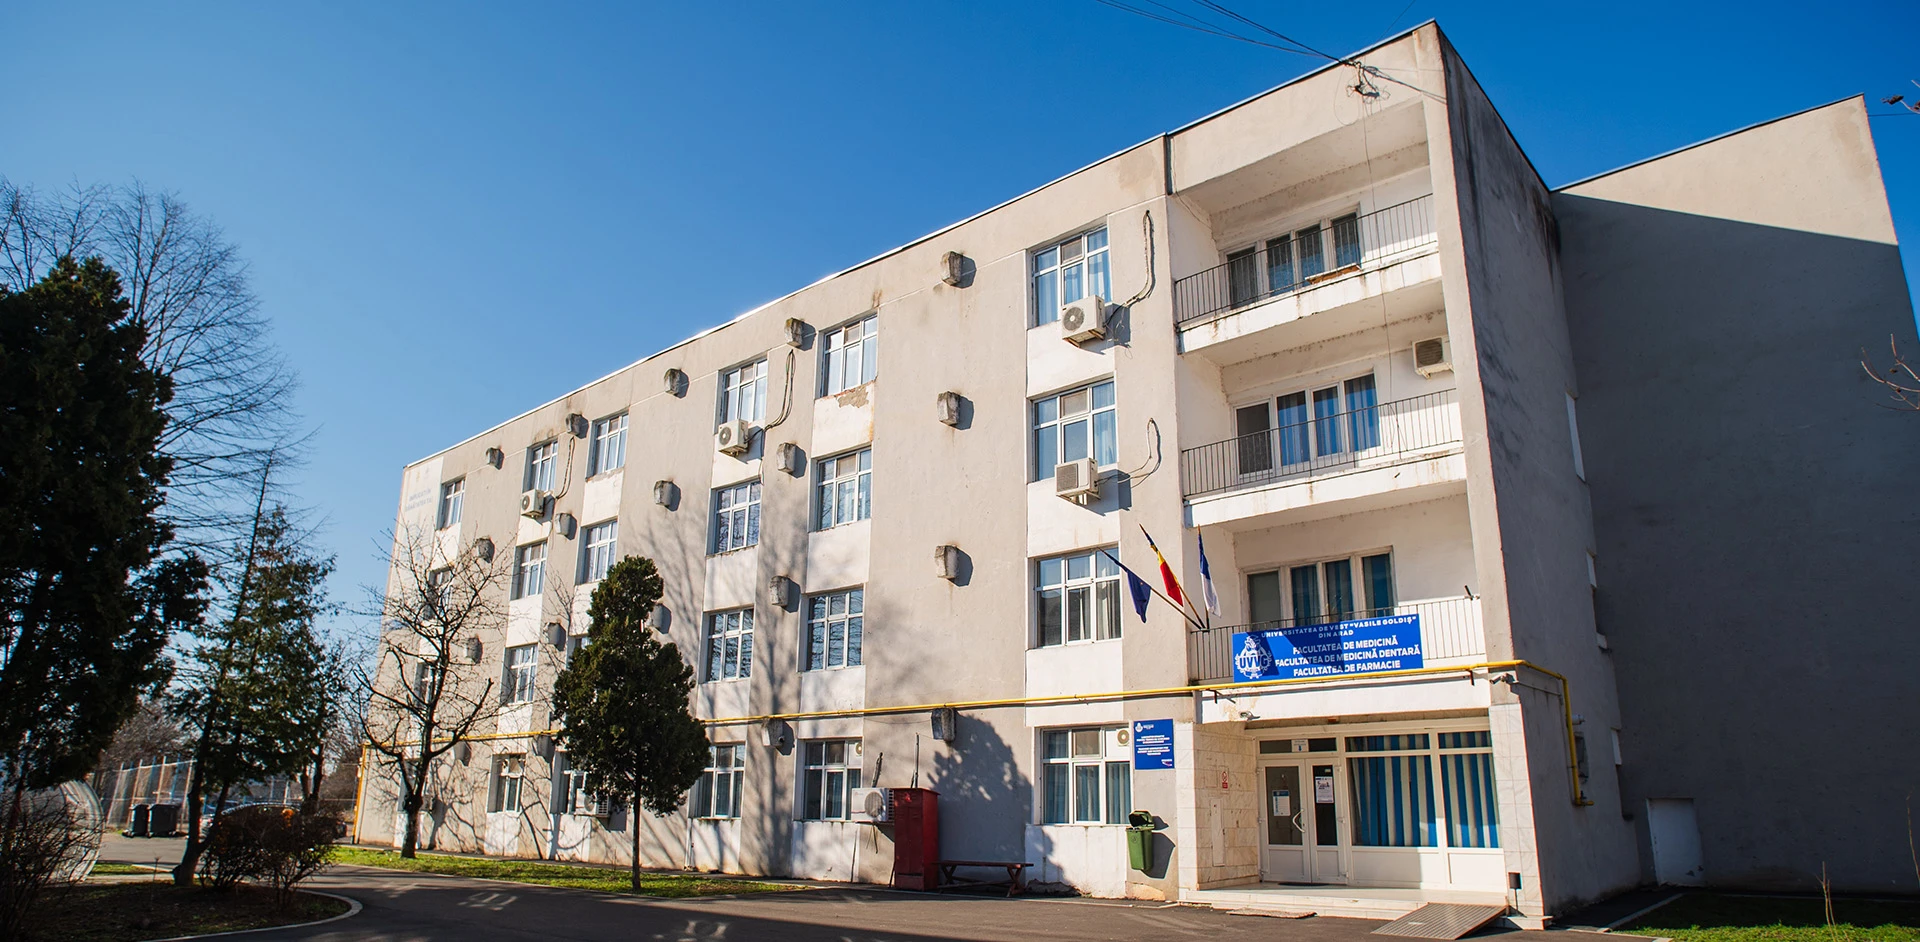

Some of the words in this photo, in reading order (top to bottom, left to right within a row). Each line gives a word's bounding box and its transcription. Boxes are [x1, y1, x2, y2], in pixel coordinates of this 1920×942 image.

[1261, 627, 1317, 638] UNIVERSITATEA
[1293, 643, 1342, 655] FACULTATEA
[1343, 641, 1355, 650] DE
[1355, 635, 1398, 649] MEDICINĂ
[1275, 655, 1323, 667] FACULTATEA
[1324, 655, 1336, 663] DE
[1336, 648, 1378, 661] MEDICINĂ
[1379, 644, 1421, 658] DENTARĂ
[1293, 665, 1343, 677] FACULTATEA
[1344, 663, 1355, 673] DE
[1356, 660, 1401, 671] FARMACIE
